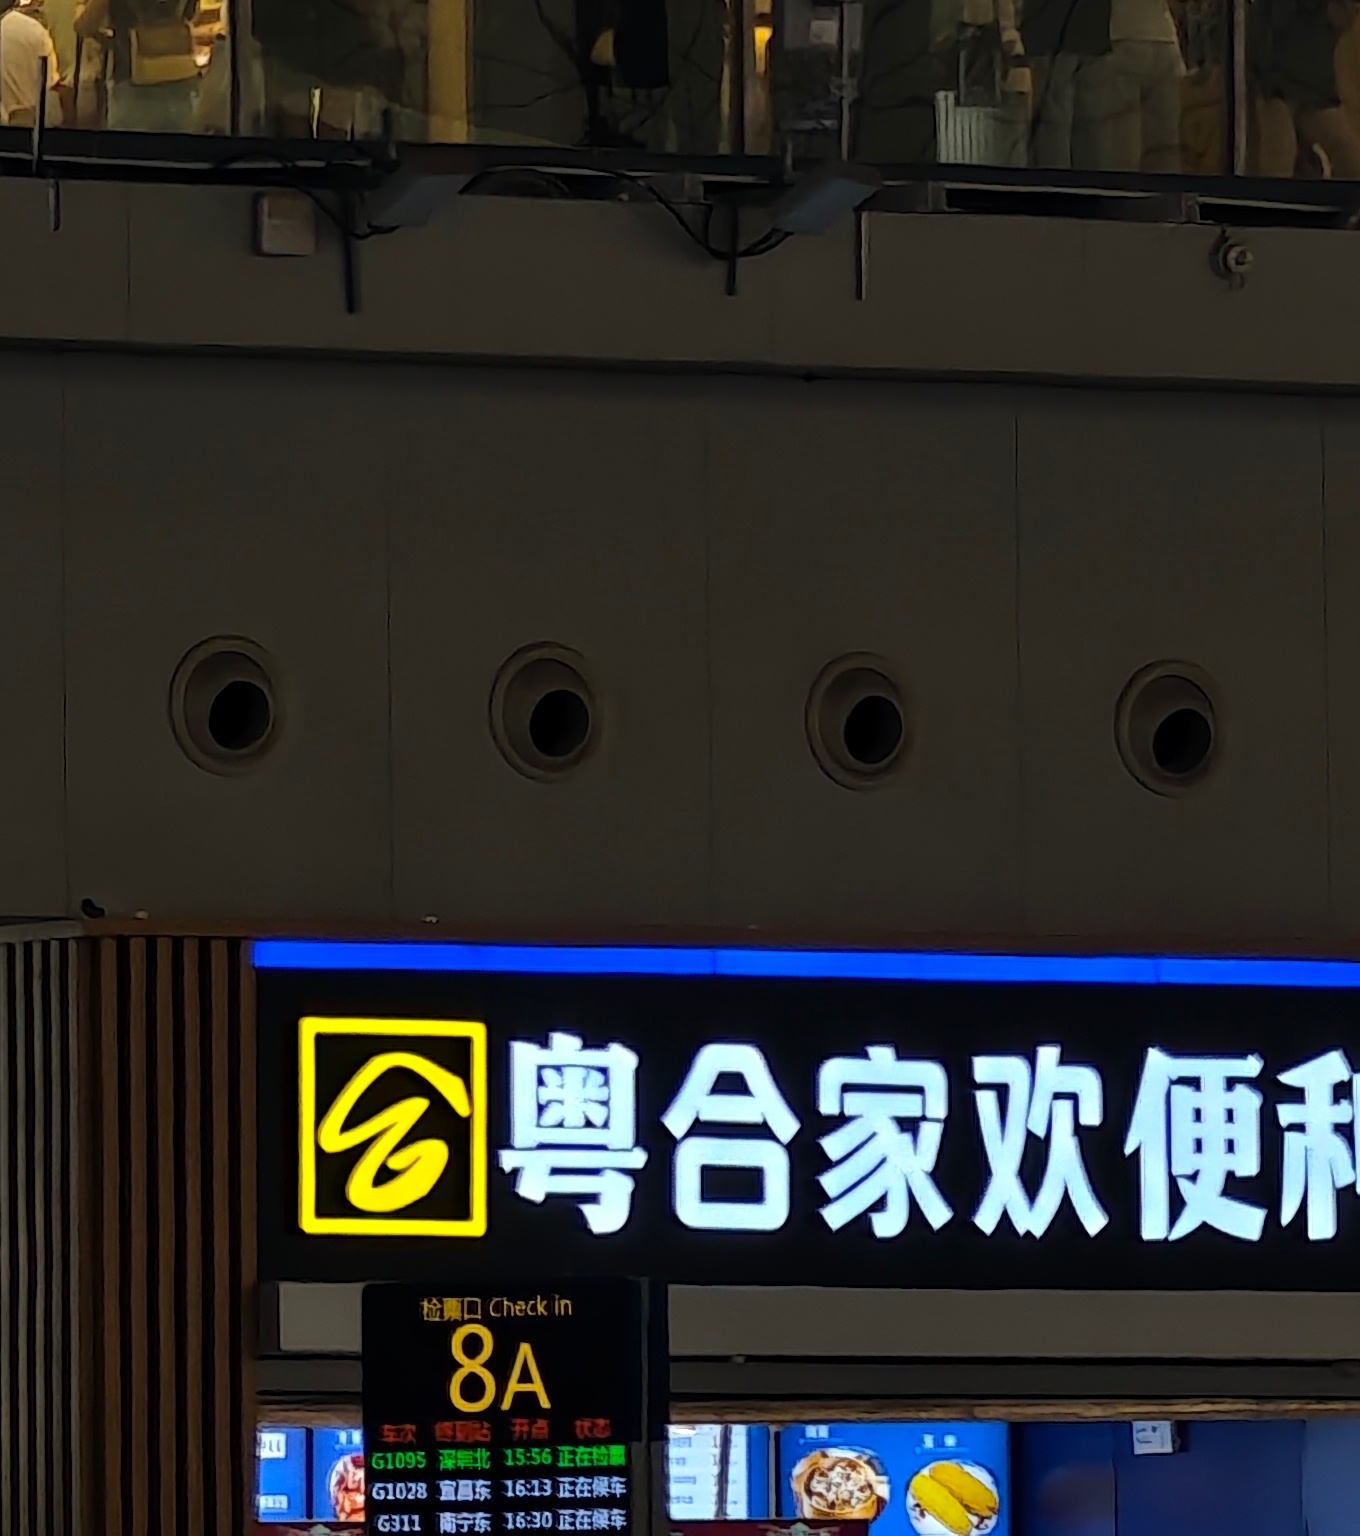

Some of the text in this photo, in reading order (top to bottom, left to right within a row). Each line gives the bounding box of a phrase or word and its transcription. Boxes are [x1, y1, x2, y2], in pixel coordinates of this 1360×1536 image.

[489, 1295, 548, 1317] Check
[554, 1294, 573, 1316] in
[449, 1323, 552, 1413] 8A
[371, 1451, 427, 1470] G1095
[505, 1447, 552, 1466] 15:56
[371, 1481, 428, 1501] G1028
[504, 1478, 553, 1498] 16:13
[377, 1514, 422, 1533] G311
